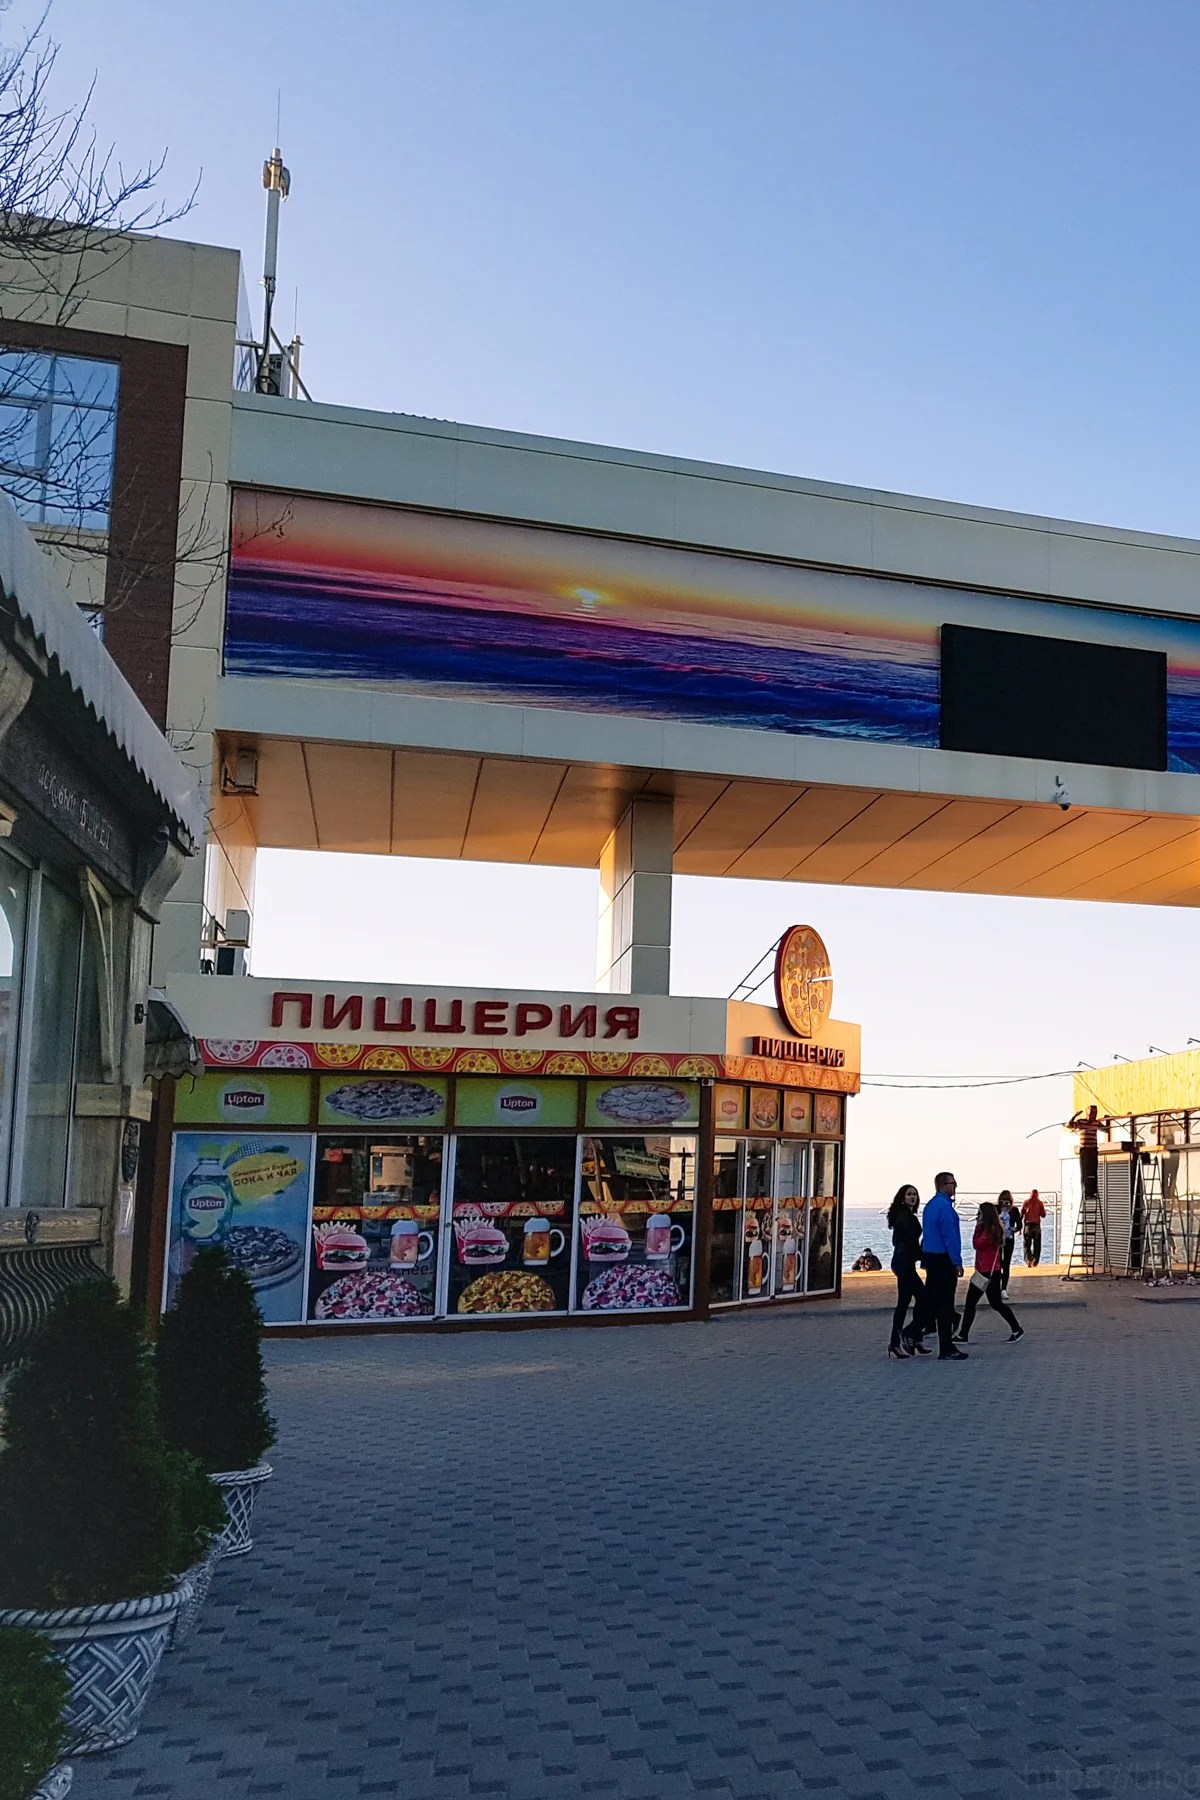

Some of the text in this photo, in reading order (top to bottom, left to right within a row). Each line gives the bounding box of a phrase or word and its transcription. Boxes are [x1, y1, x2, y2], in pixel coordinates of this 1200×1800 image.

[271, 991, 640, 1039] ПИЦЦЕРИЯ
[754, 1036, 845, 1067] ПИЦЦЕРИЯ
[228, 1094, 261, 1105] Lipton
[502, 1098, 534, 1109] Lipton
[233, 1175, 265, 1186] СОКА
[277, 1167, 298, 1178] ЧАЯ
[191, 1198, 222, 1210] Lipton
